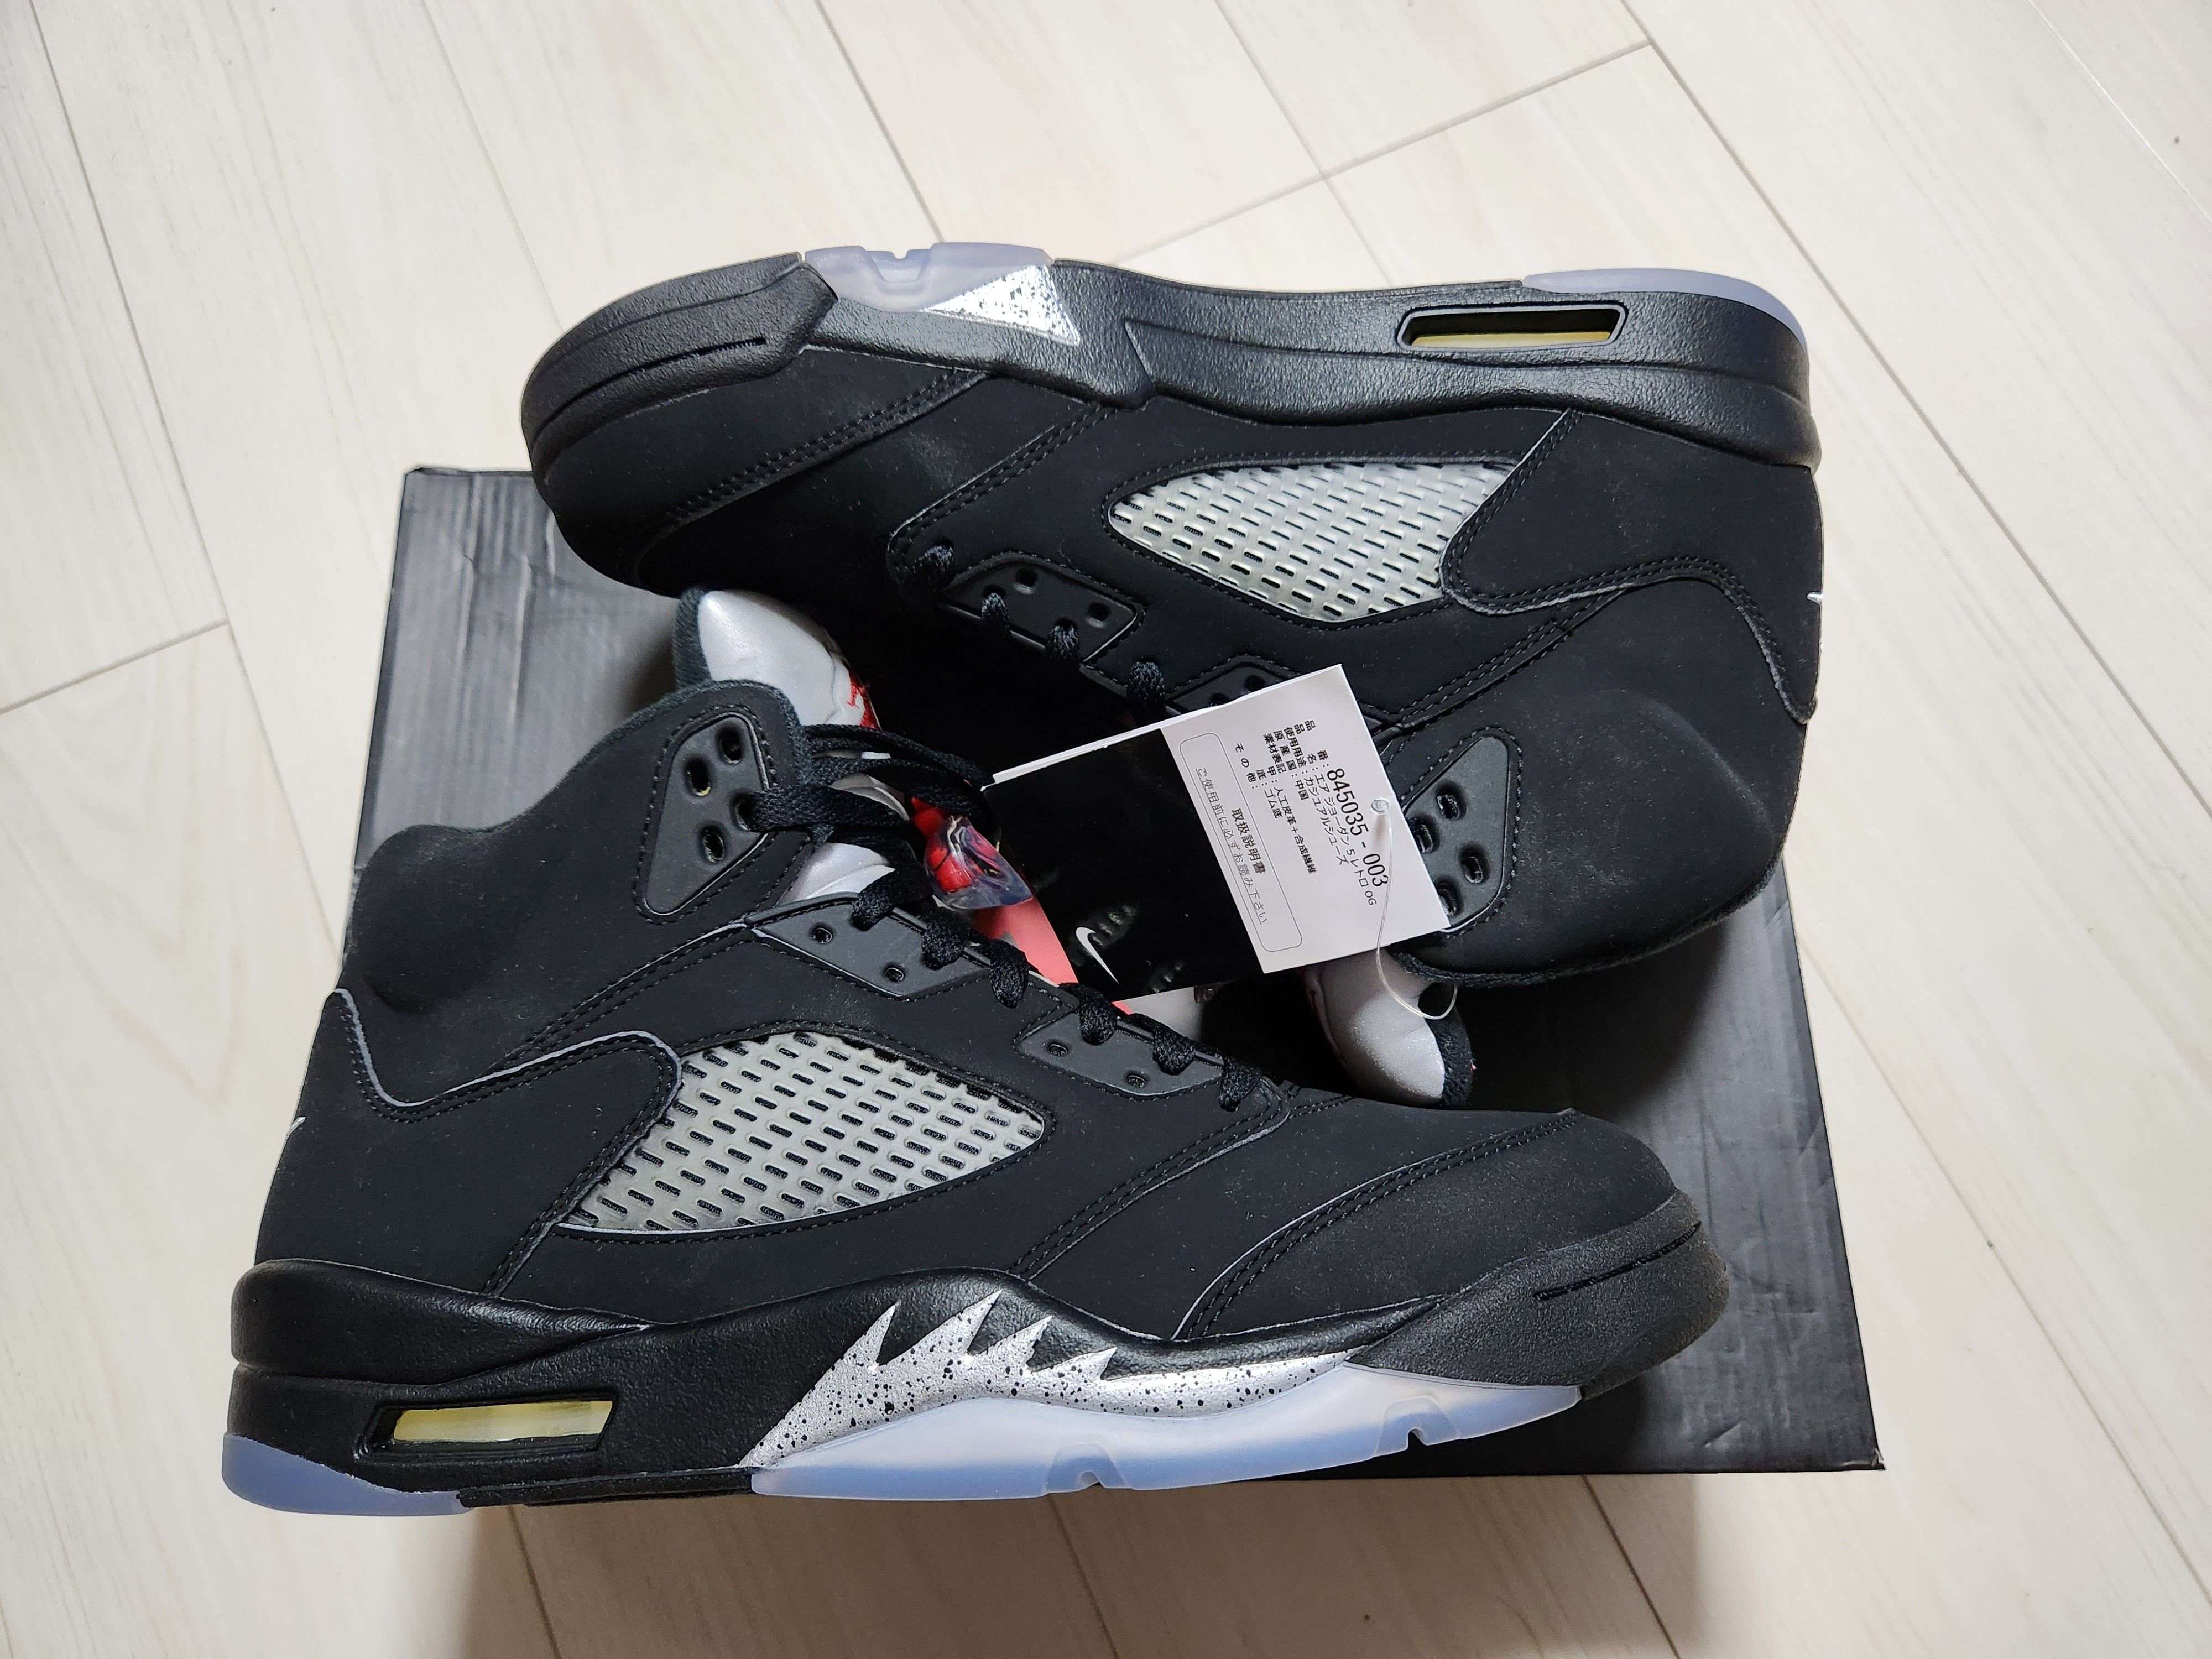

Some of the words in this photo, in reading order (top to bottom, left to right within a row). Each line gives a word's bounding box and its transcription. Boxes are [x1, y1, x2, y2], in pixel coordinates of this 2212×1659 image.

[1262, 733, 1287, 774] 素材表記
[1231, 807, 1266, 874] 取扱説明書
[1327, 768, 1369, 836] 845035
[1362, 853, 1391, 887] 003
[1364, 890, 1377, 906] OG
